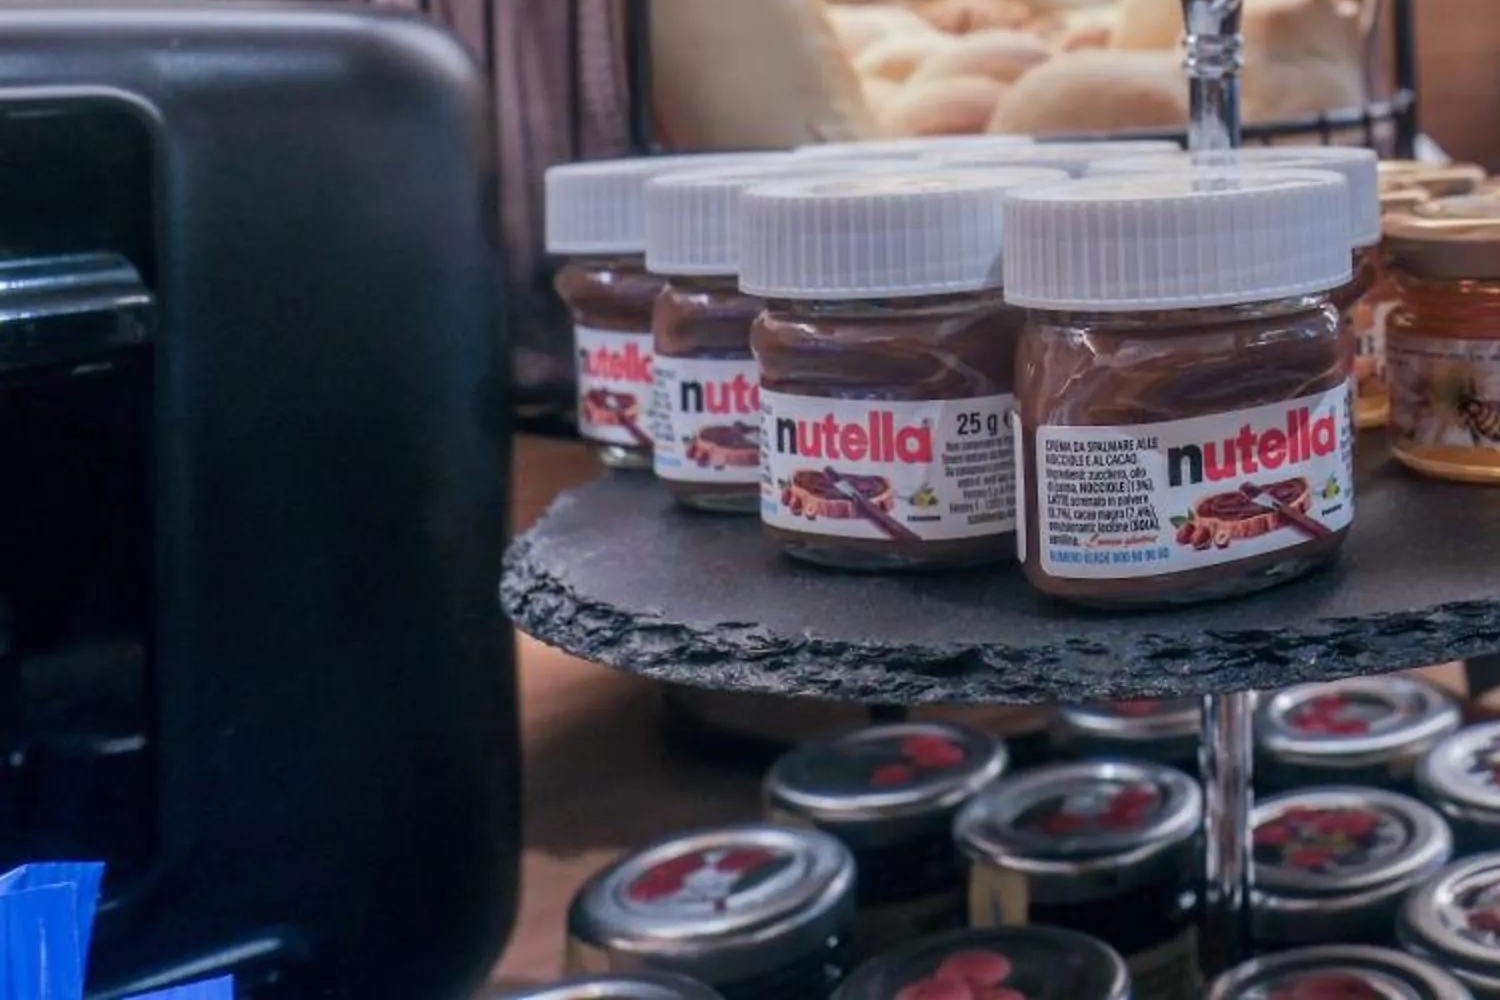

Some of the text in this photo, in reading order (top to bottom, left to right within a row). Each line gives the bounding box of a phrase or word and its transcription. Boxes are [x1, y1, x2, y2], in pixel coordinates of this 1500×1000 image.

[777, 410, 932, 463] nutella
[957, 412, 998, 437] 25 g
[1168, 406, 1336, 487] nutella
